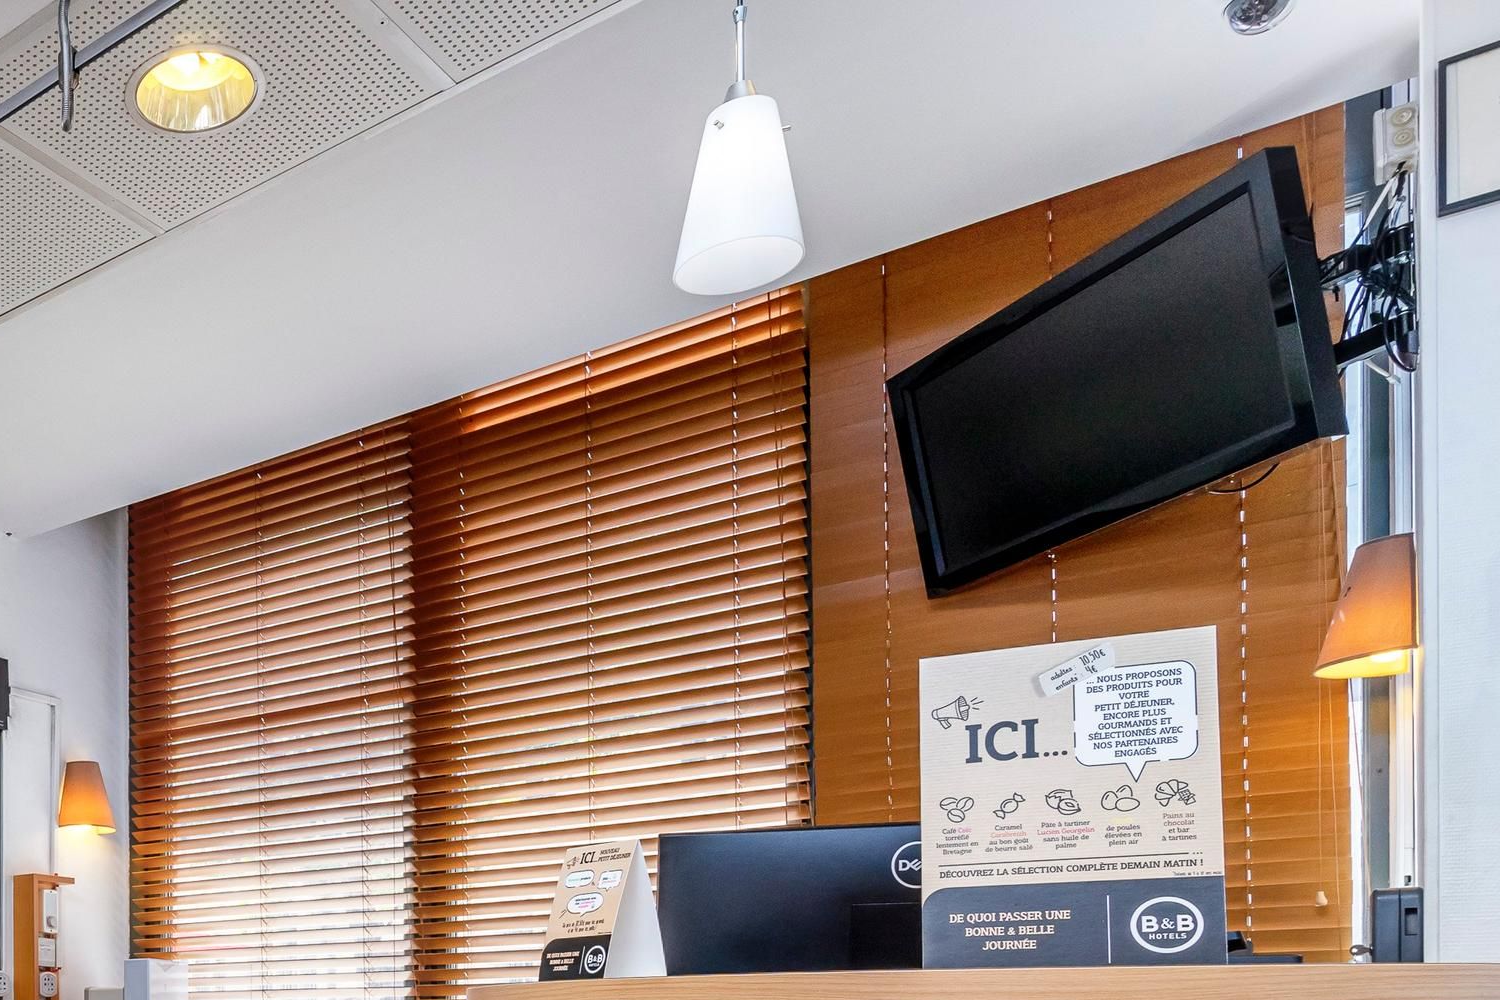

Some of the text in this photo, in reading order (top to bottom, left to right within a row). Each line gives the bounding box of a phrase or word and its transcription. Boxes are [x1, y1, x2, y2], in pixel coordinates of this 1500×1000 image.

[1050, 667, 1073, 681] adultes
[1084, 665, 1098, 674] 4€
[1096, 673, 1123, 684] NOUS
[1125, 668, 1182, 681] PROPOSONS
[1055, 676, 1078, 691] enfants
[1086, 678, 1183, 694] DES PRODUITS POUR
[1118, 690, 1150, 700] VOTRE
[1094, 702, 1121, 712] PETIT
[1103, 708, 1167, 721] ENCORE PLUS
[1098, 717, 1173, 730] GOURMANDS ET
[1088, 726, 1184, 741] SÉLECTIONNÉS AVEC
[1093, 736, 1179, 750] NOS PARTENAIRES
[1114, 747, 1157, 758] ENGAGÉS
[994, 823, 1023, 831] Caramel
[1116, 824, 1141, 832] poules
[1163, 819, 1195, 827] chocolat
[1055, 842, 1077, 850] palme
[1109, 839, 1127, 847] plein
[942, 848, 972, 856] Bretagne
[940, 869, 994, 879] DÉCOUVREZ
[996, 868, 1009, 876] LA
[1011, 865, 1064, 876] SÉLECTION
[1066, 861, 1118, 873] COMPLÈTE
[1120, 861, 1160, 870] DEMAIN
[1163, 859, 1197, 868] MATIN
[949, 909, 1071, 924] DE QUOI PASSER UNE
[965, 924, 1055, 937] BONNE & BELLE
[1141, 914, 1195, 934] B&B
[1149, 932, 1187, 941] HOTELS
[982, 938, 1037, 951] JOURNÉE
